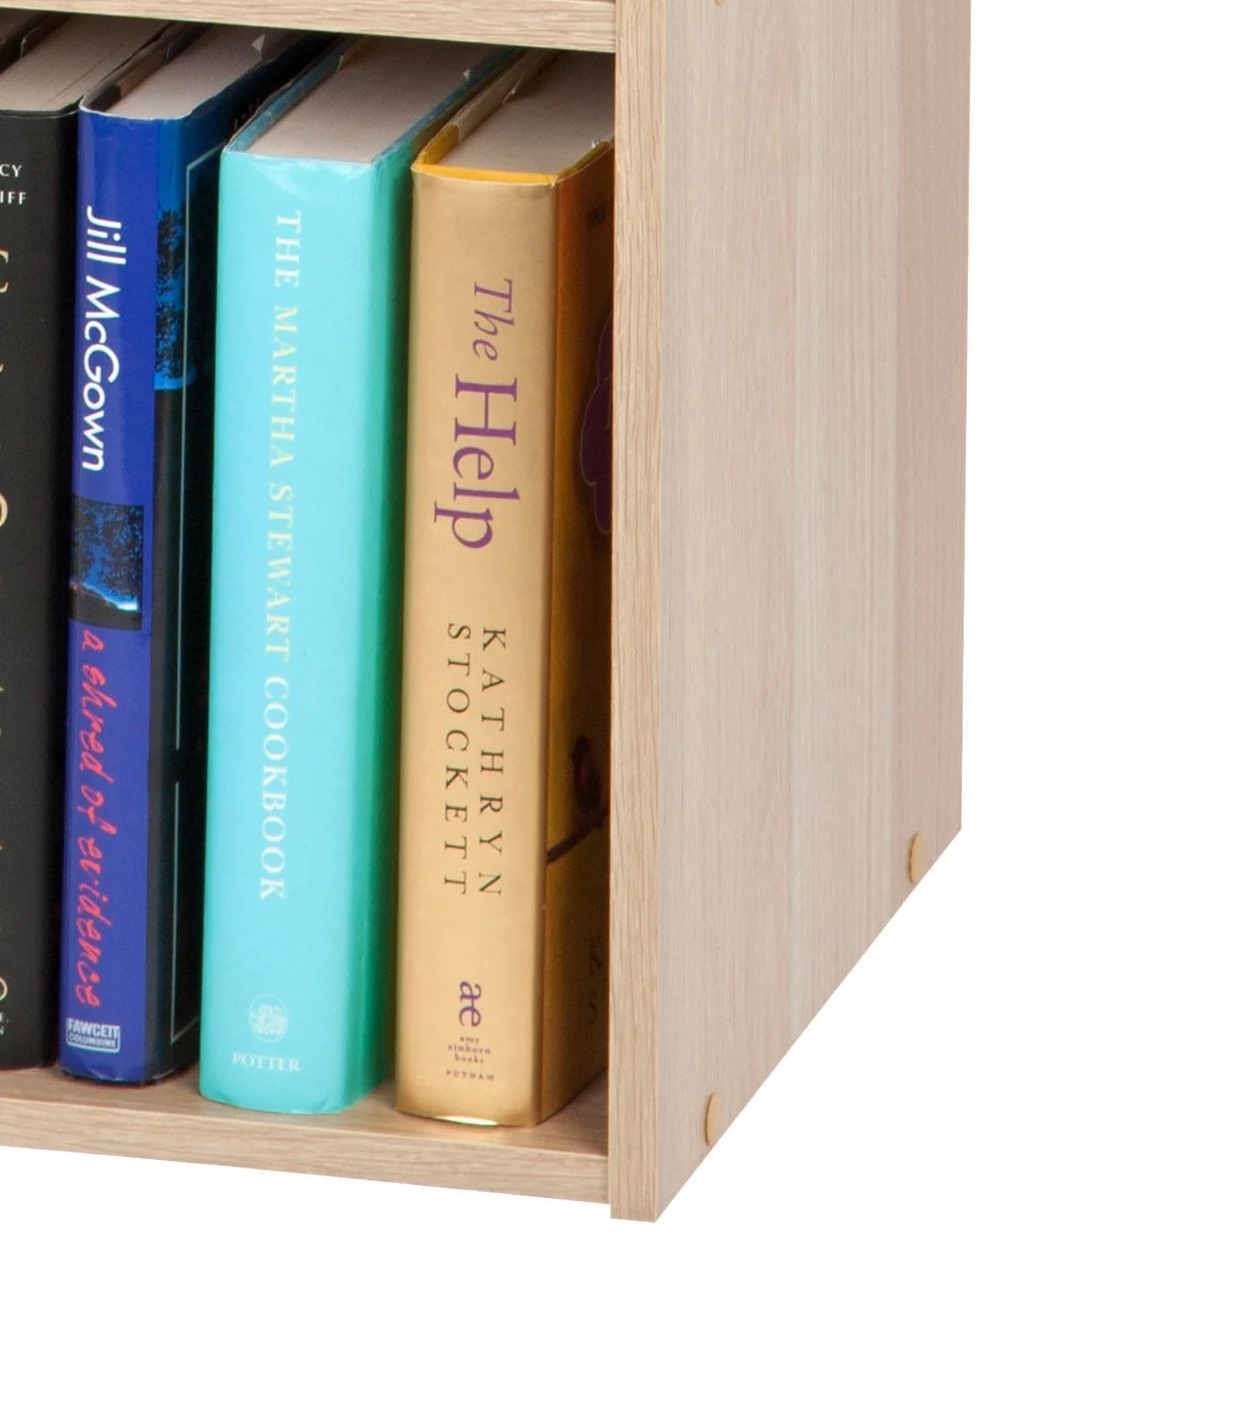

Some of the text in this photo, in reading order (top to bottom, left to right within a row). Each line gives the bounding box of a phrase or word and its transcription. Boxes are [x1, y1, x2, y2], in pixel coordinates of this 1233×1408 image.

[82, 205, 127, 473] Jill McGown
[433, 278, 521, 549] The Help
[260, 210, 302, 902] THE MARTHA STEWART COOKBOOK
[75, 628, 118, 1009] a shred of evidence
[443, 622, 472, 896] STOCKETT
[478, 625, 508, 896] KATHRYN
[67, 1018, 120, 1039] FAWCETT
[232, 1051, 300, 1073] POTTER
[446, 1069, 495, 1081] PUTNAM
[447, 1044, 492, 1055] einhorn
[454, 1053, 484, 1064] books
